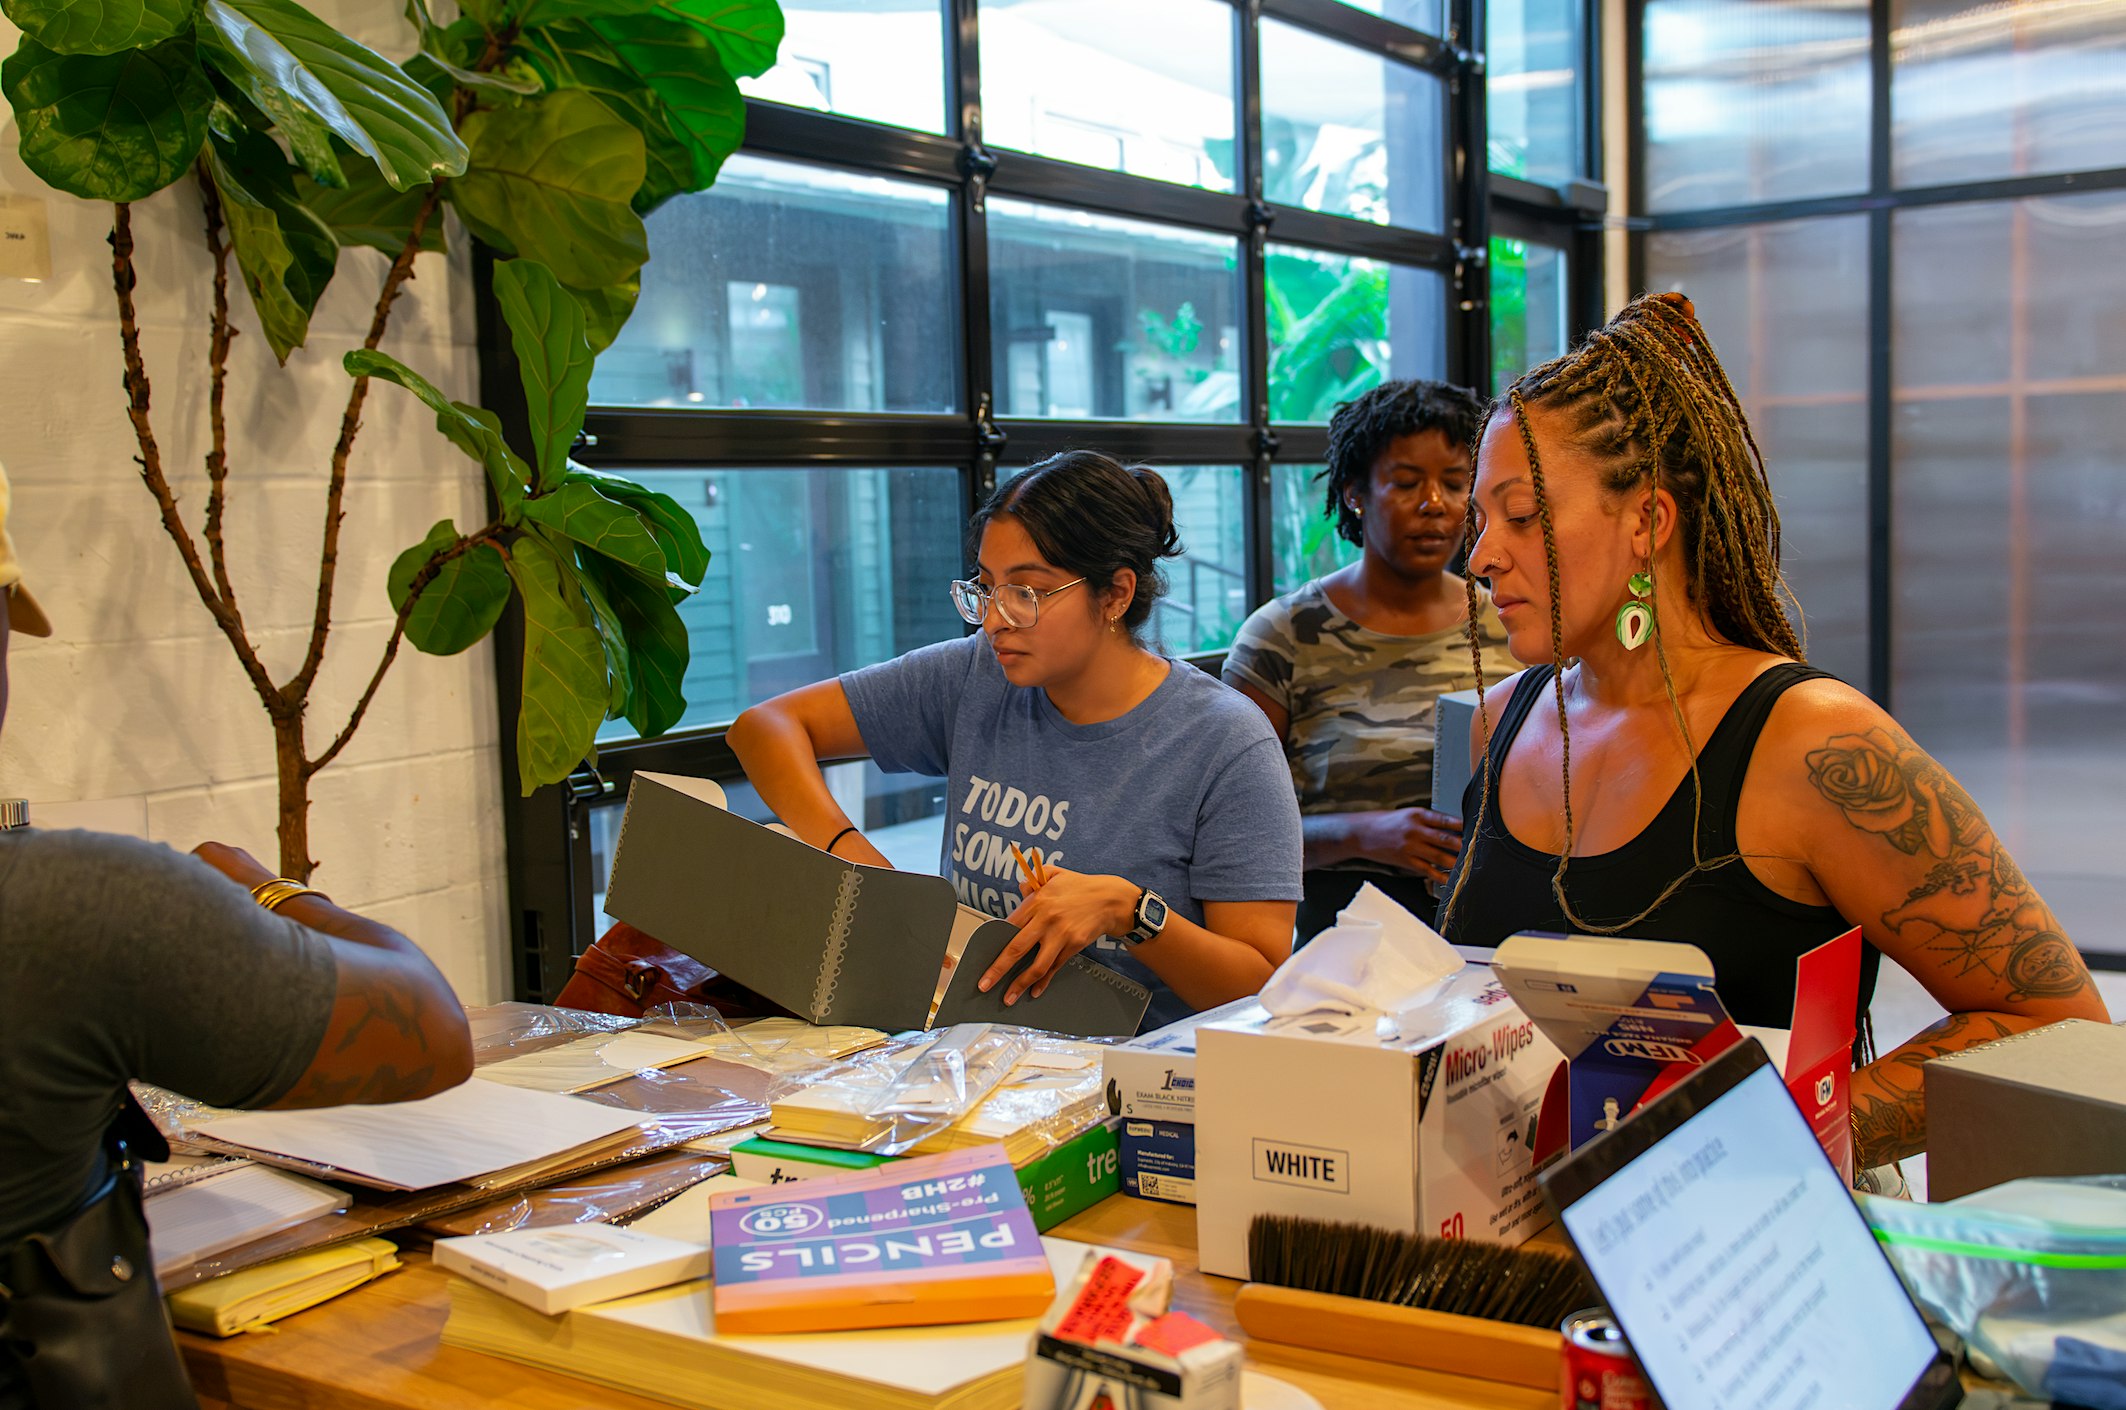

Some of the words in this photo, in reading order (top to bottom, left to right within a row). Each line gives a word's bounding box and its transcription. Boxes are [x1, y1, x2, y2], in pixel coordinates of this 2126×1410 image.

[961, 775, 1070, 841] TODOS
[1446, 1020, 1534, 1087] Micro-Wipes
[1622, 1041, 1680, 1060] IFM
[1171, 1077, 1195, 1089] CHOIC
[1136, 1091, 1154, 1099] EXAM
[1156, 1093, 1175, 1101] BLACK
[1126, 1103, 1134, 1114] S
[1158, 1130, 1180, 1139] MEDICAL
[1266, 1149, 1336, 1183] WHITE
[901, 1173, 986, 1201] #2HB
[760, 1207, 802, 1218] PCS
[827, 1192, 1000, 1230] Pre-Sharpened
[754, 1214, 809, 1232] 50
[740, 1223, 1016, 1272] PENCILS
